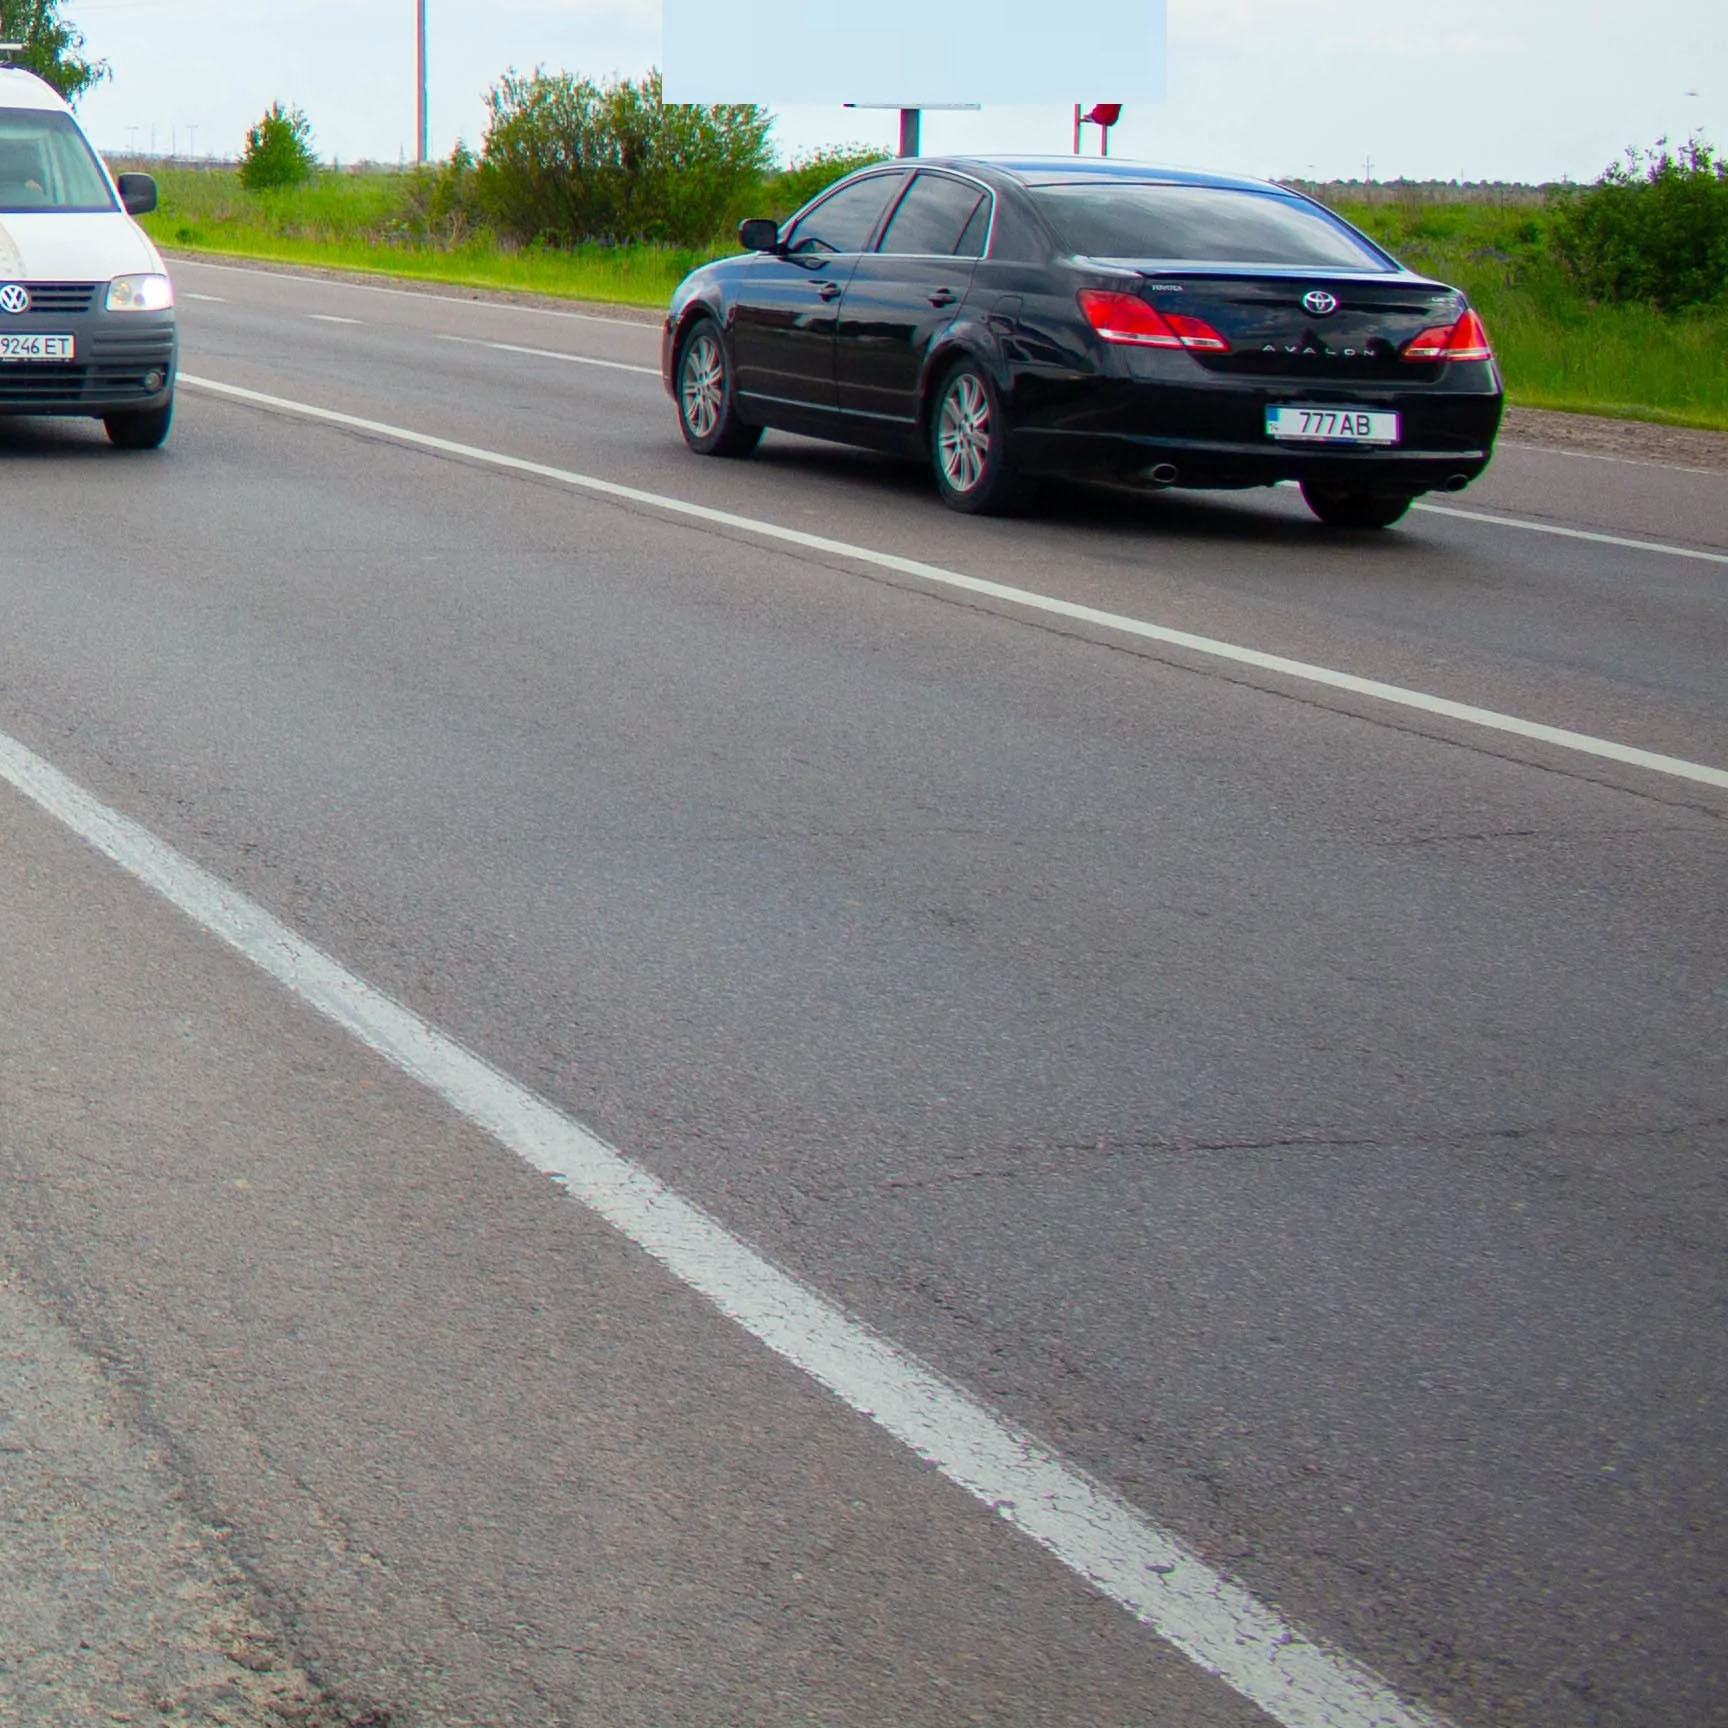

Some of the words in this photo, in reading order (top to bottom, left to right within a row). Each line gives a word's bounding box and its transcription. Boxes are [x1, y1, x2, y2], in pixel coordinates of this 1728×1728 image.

[1, 337, 40, 355] 9246
[45, 337, 70, 355] ET
[1262, 344, 1375, 357] AVALON
